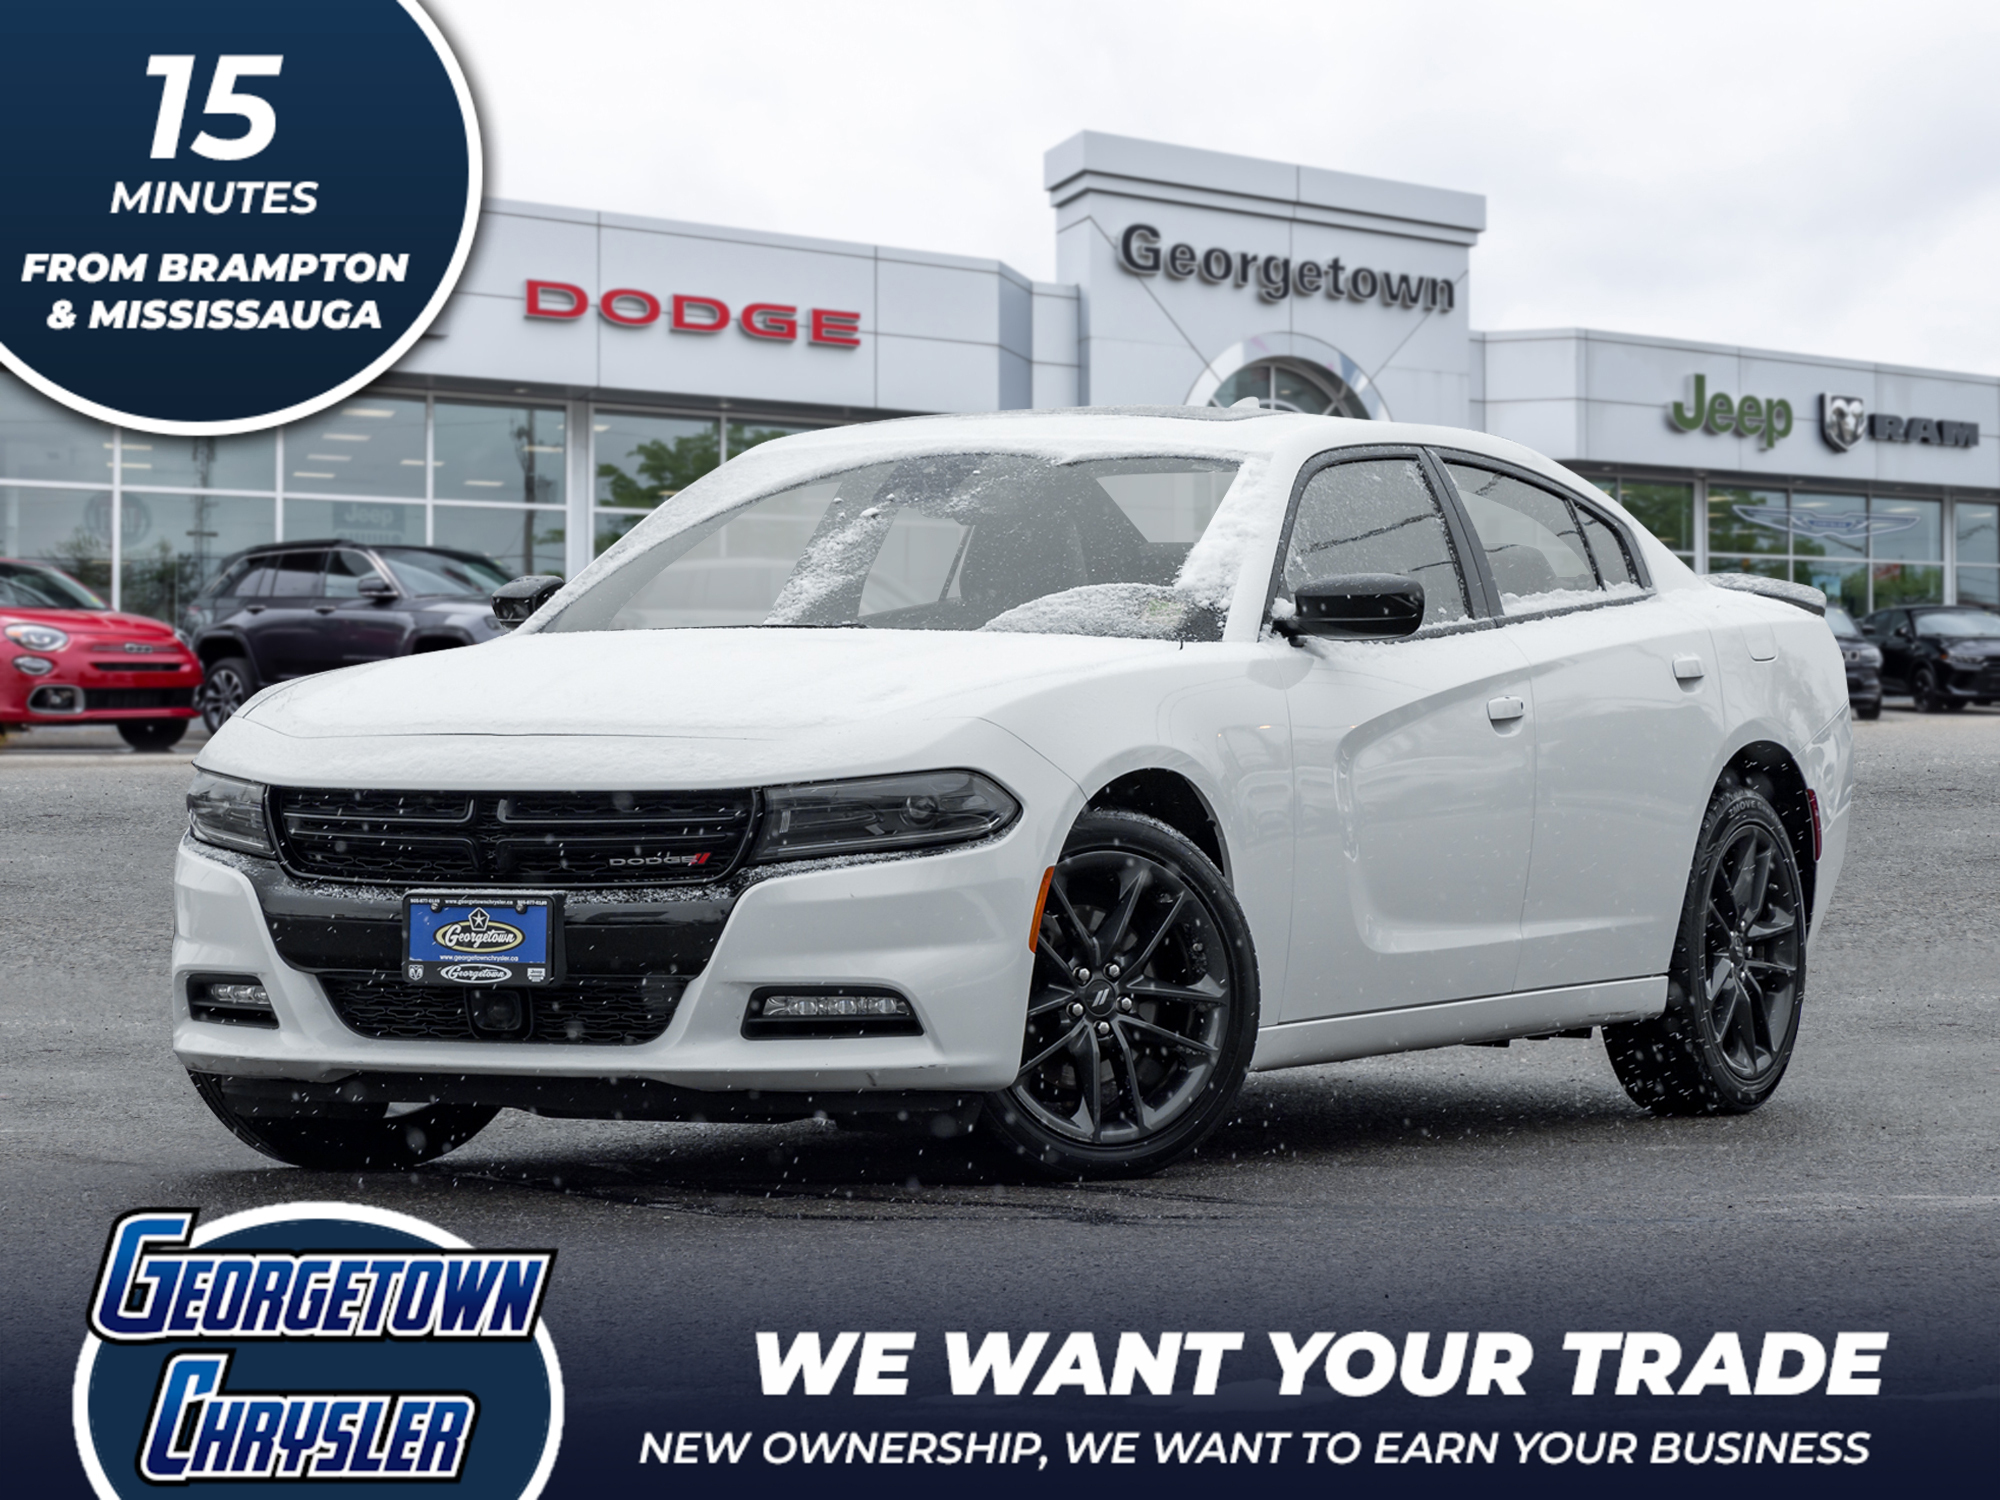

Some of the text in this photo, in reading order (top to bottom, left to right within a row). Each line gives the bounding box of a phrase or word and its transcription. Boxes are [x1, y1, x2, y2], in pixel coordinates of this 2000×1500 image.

[1120, 223, 1455, 311] Georgetown
[524, 279, 861, 348] DODGE
[1668, 373, 1793, 449] Jeep
[1868, 413, 1980, 447] RAM
[344, 503, 394, 528] Jeep
[609, 855, 697, 866] DODGE
[445, 924, 516, 948] Georgetown
[439, 954, 519, 962] www.georgetownchrysler.ca
[448, 965, 506, 981] Georgetown
